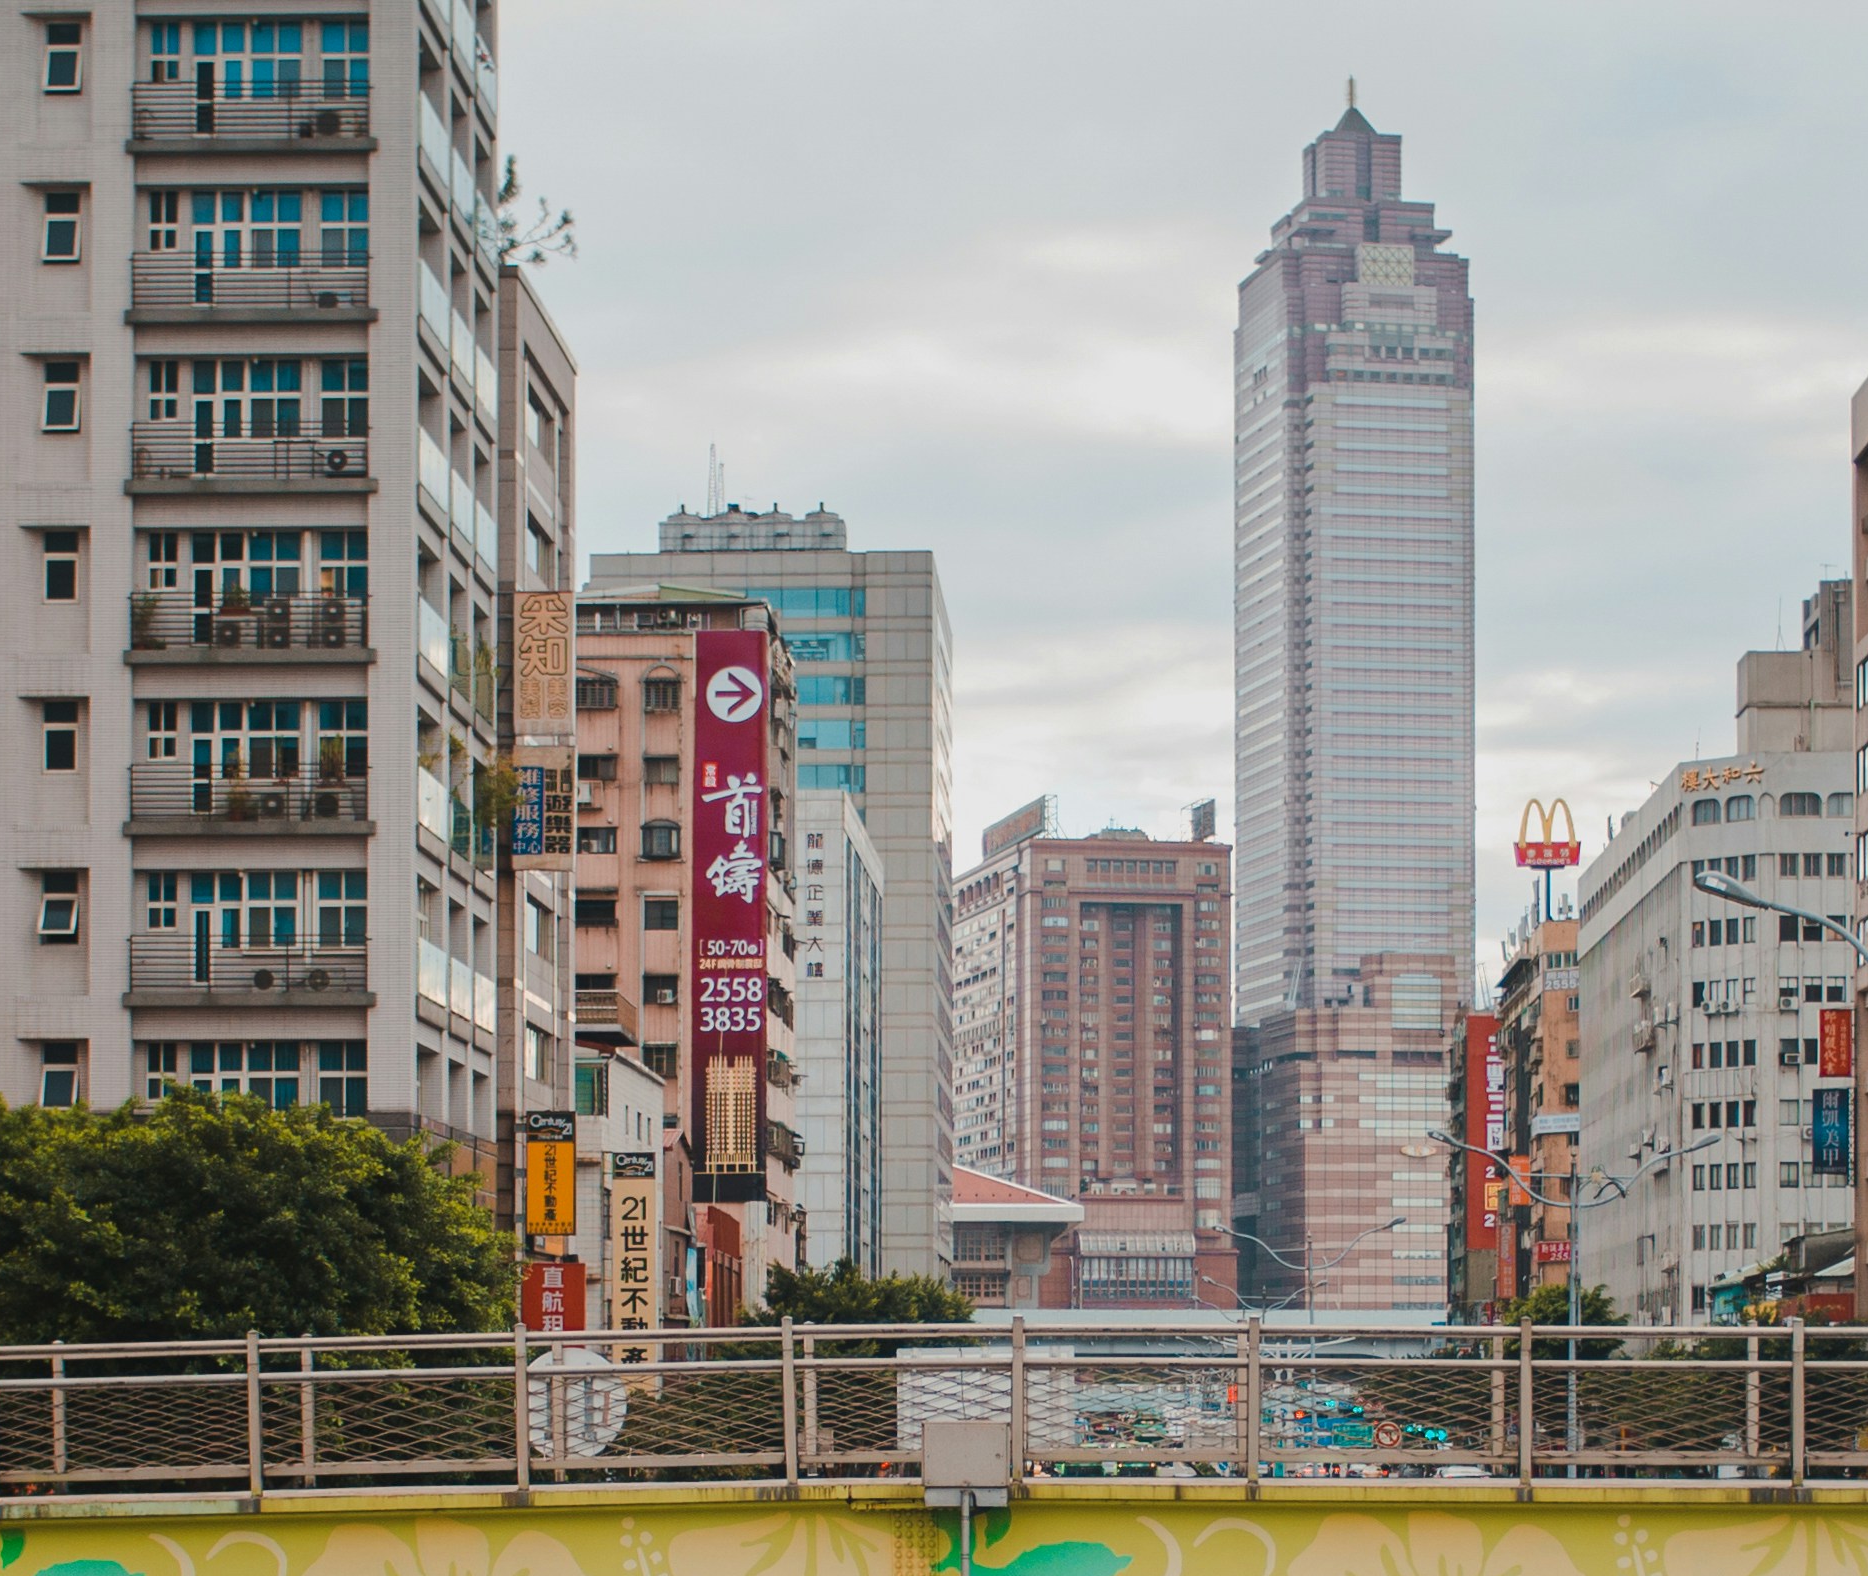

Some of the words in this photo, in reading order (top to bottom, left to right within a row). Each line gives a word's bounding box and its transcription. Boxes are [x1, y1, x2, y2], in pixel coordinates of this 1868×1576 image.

[513, 841, 541, 854] 中心
[806, 833, 823, 978] 龍德企業大樓
[700, 978, 762, 1002] 2558
[700, 1007, 761, 1031] 3835
[530, 1114, 565, 1128] Century
[562, 1122, 573, 1135] 21
[644, 1161, 653, 1172] 21
[544, 1144, 557, 1220] 21世紀不動產
